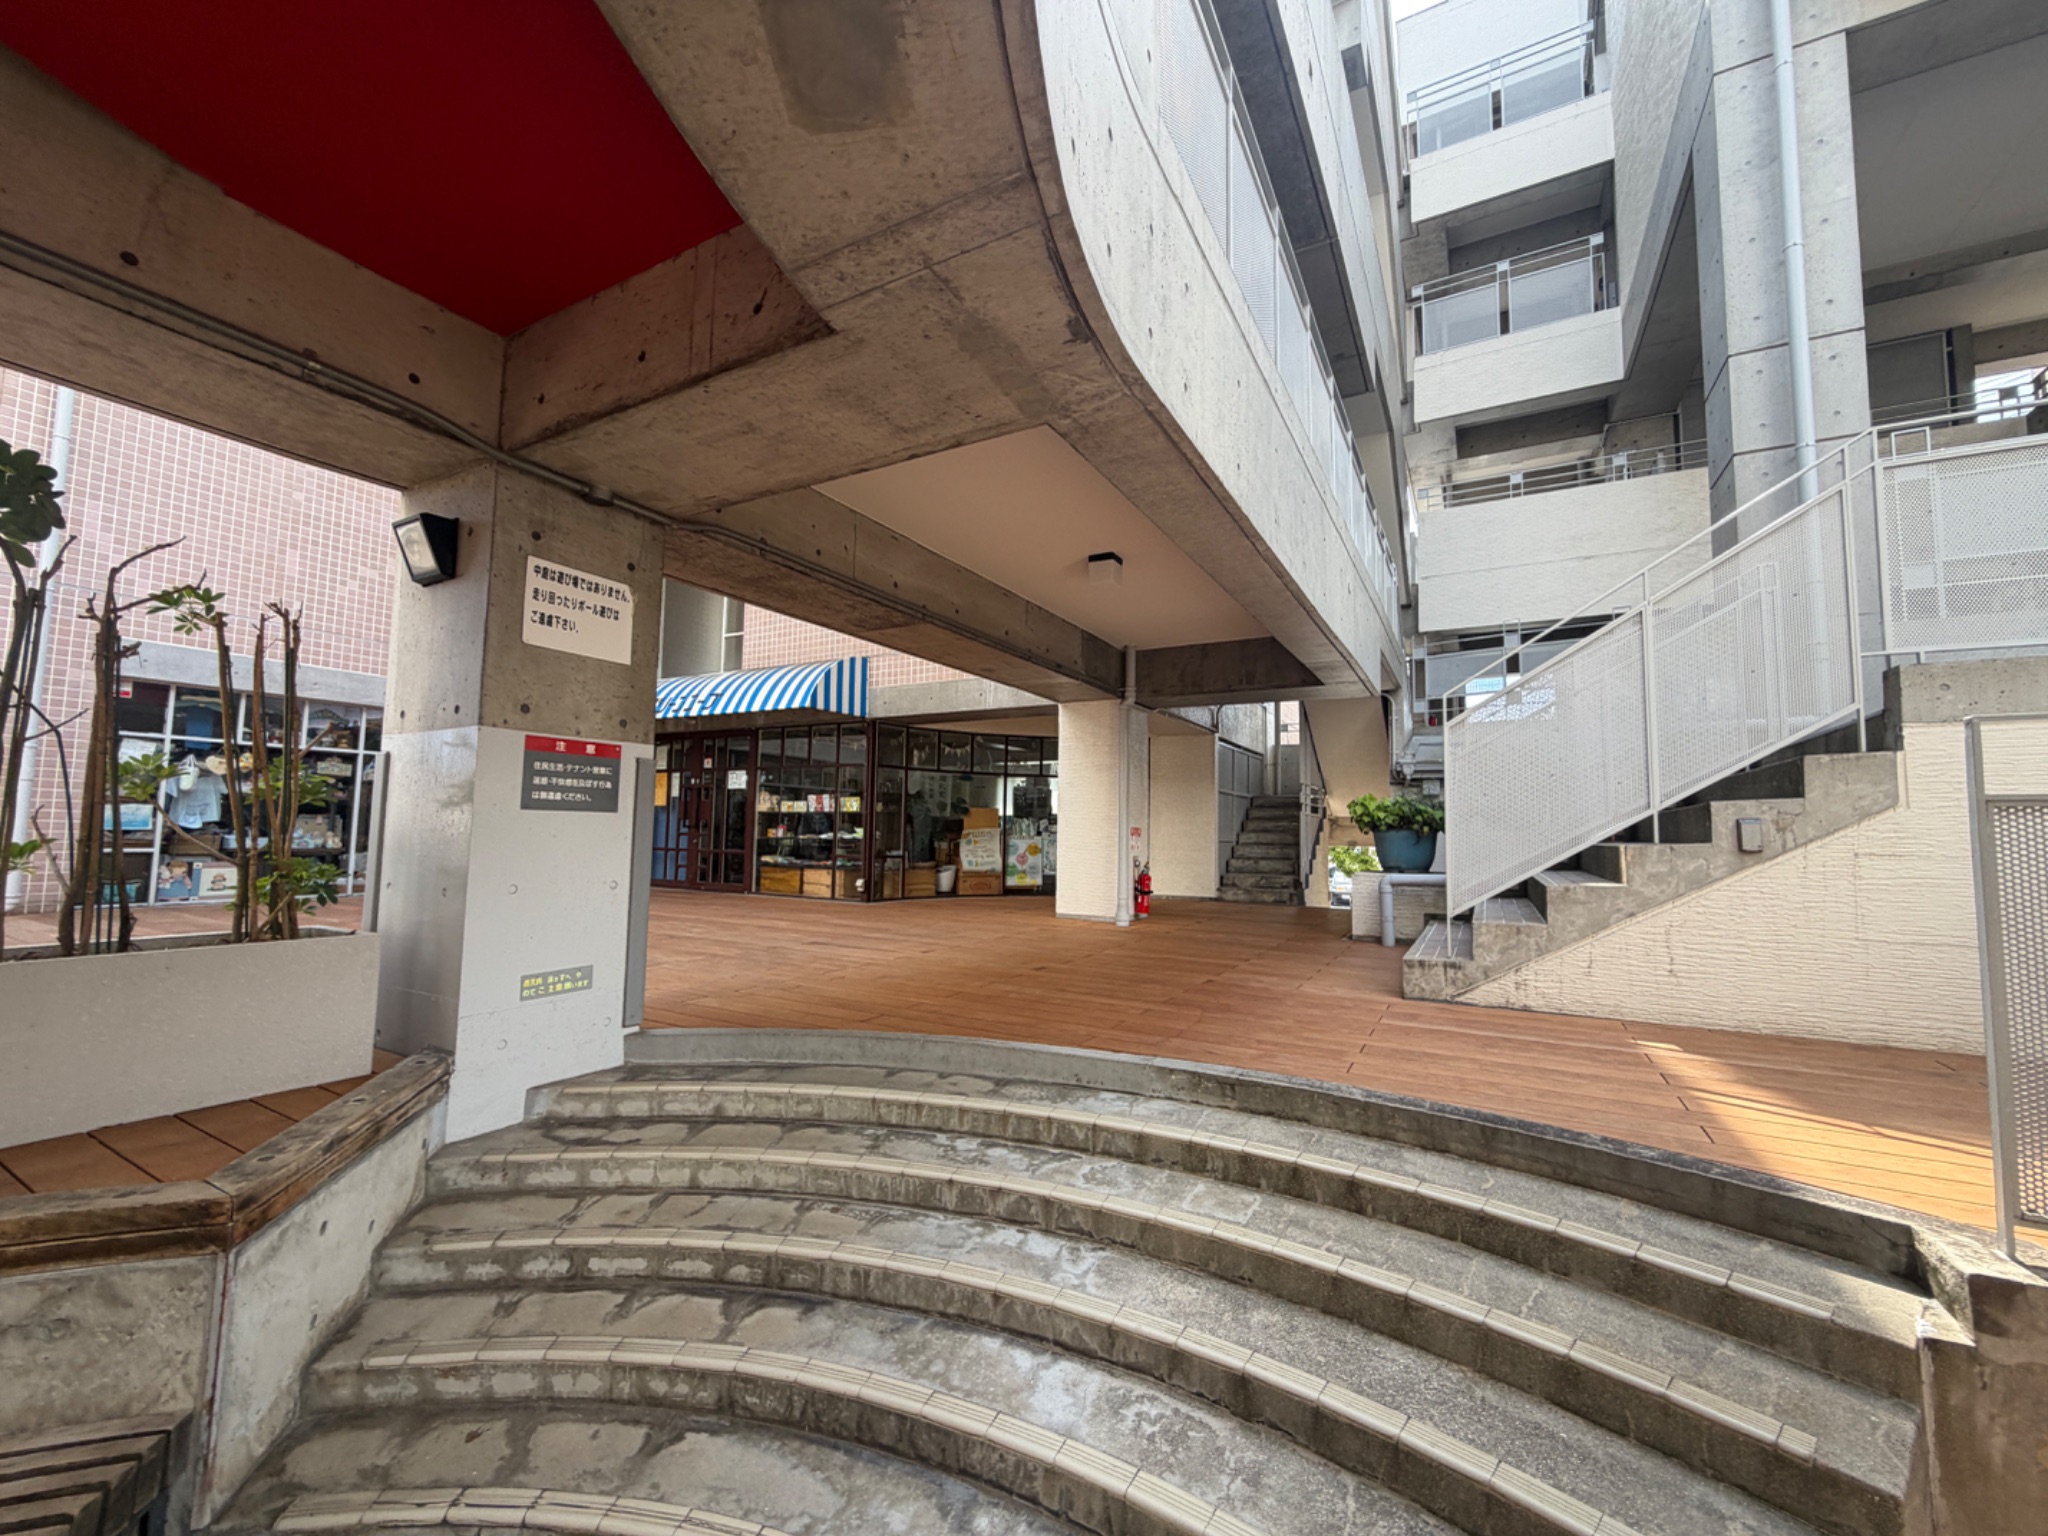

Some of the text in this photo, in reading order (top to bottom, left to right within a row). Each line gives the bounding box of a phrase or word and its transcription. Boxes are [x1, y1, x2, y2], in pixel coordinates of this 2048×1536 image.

[532, 587, 620, 621] 走り回ったりボール遊びは
